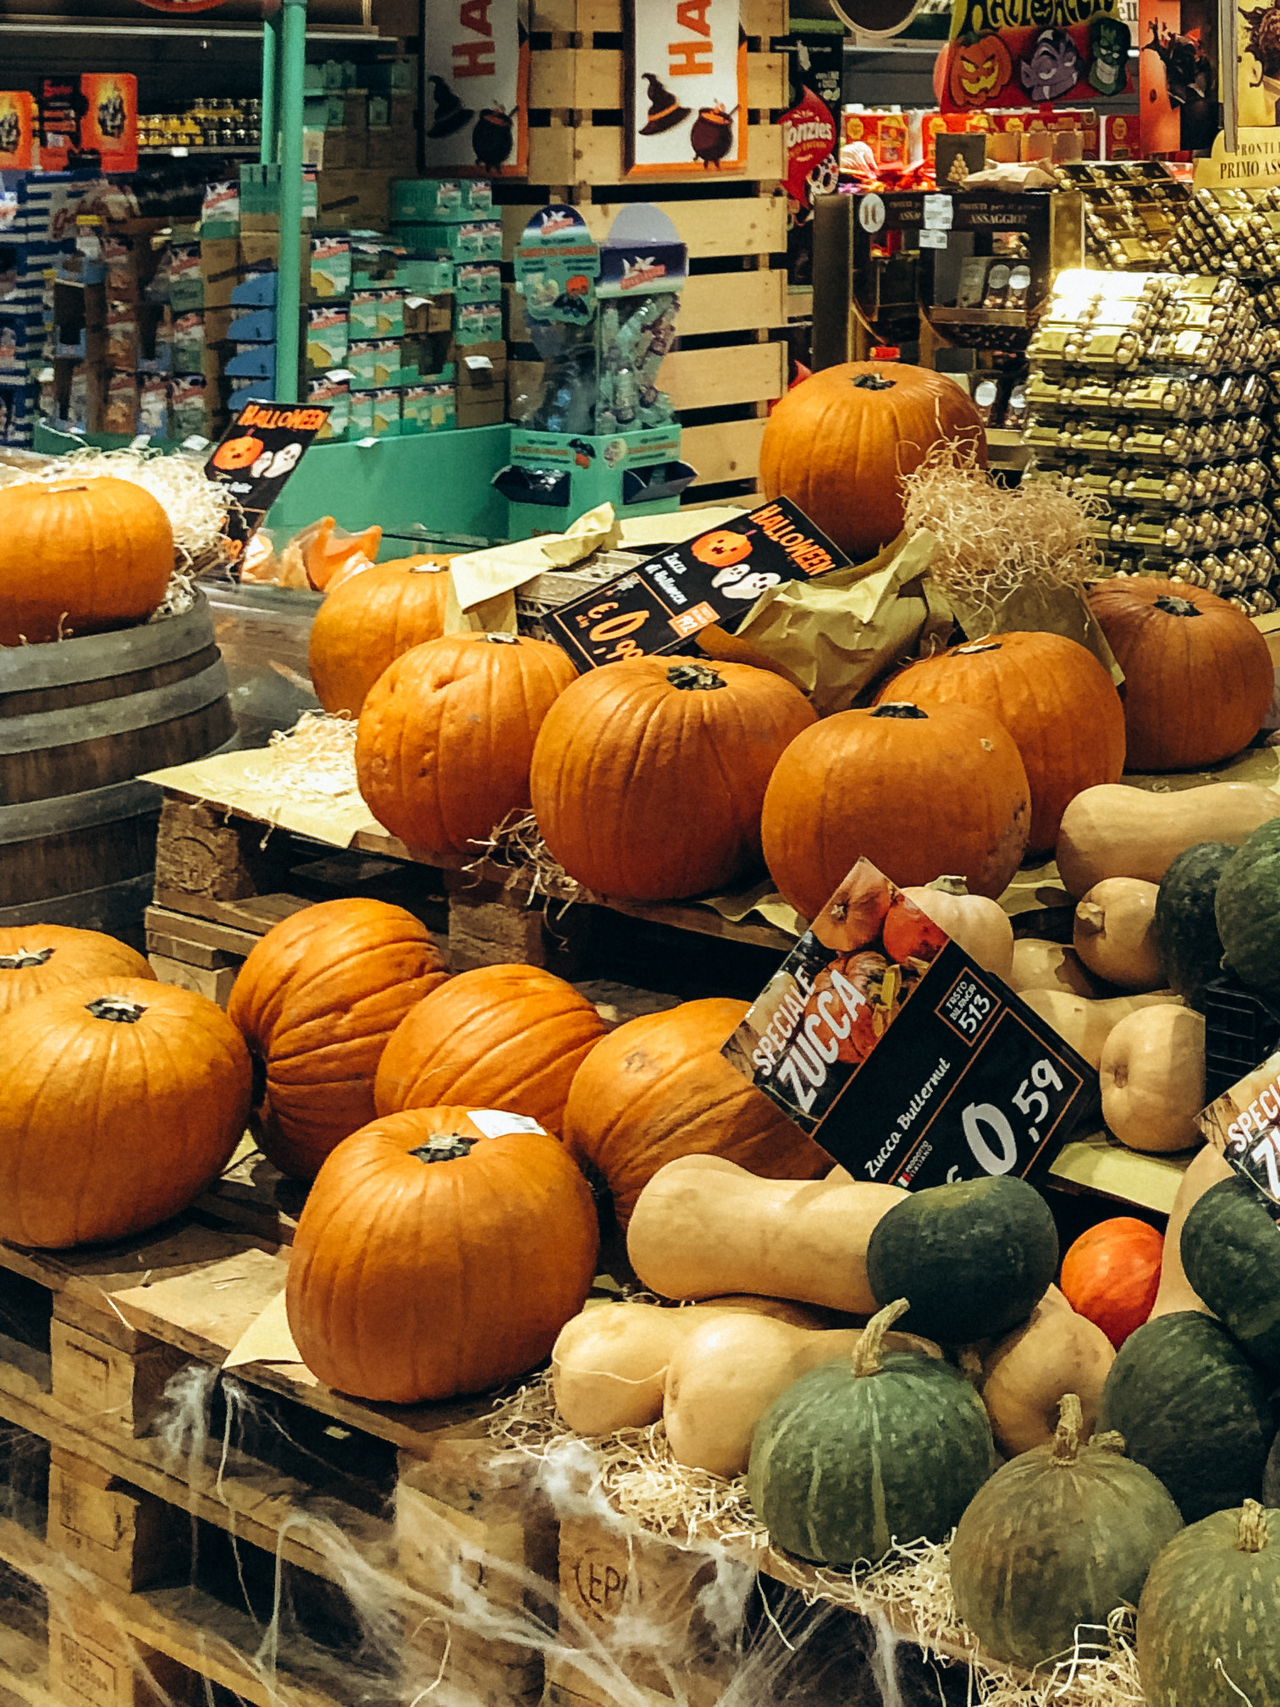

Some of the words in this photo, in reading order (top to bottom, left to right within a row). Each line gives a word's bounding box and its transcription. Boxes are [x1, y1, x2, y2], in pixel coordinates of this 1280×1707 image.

[1220, 160, 1261, 179] PRIMO
[1236, 140, 1273, 157] PRONTI
[749, 504, 836, 577] HALLOWEEN
[752, 966, 818, 1077] SPECIALE
[946, 981, 968, 1010] TASTO
[949, 983, 977, 1021] BILANCIA
[958, 994, 991, 1034] 513
[777, 969, 867, 1113] ZUCCA
[864, 1131, 902, 1179] Zucca
[896, 1057, 951, 1131] Butternut
[961, 1058, 1064, 1176] 0,59
